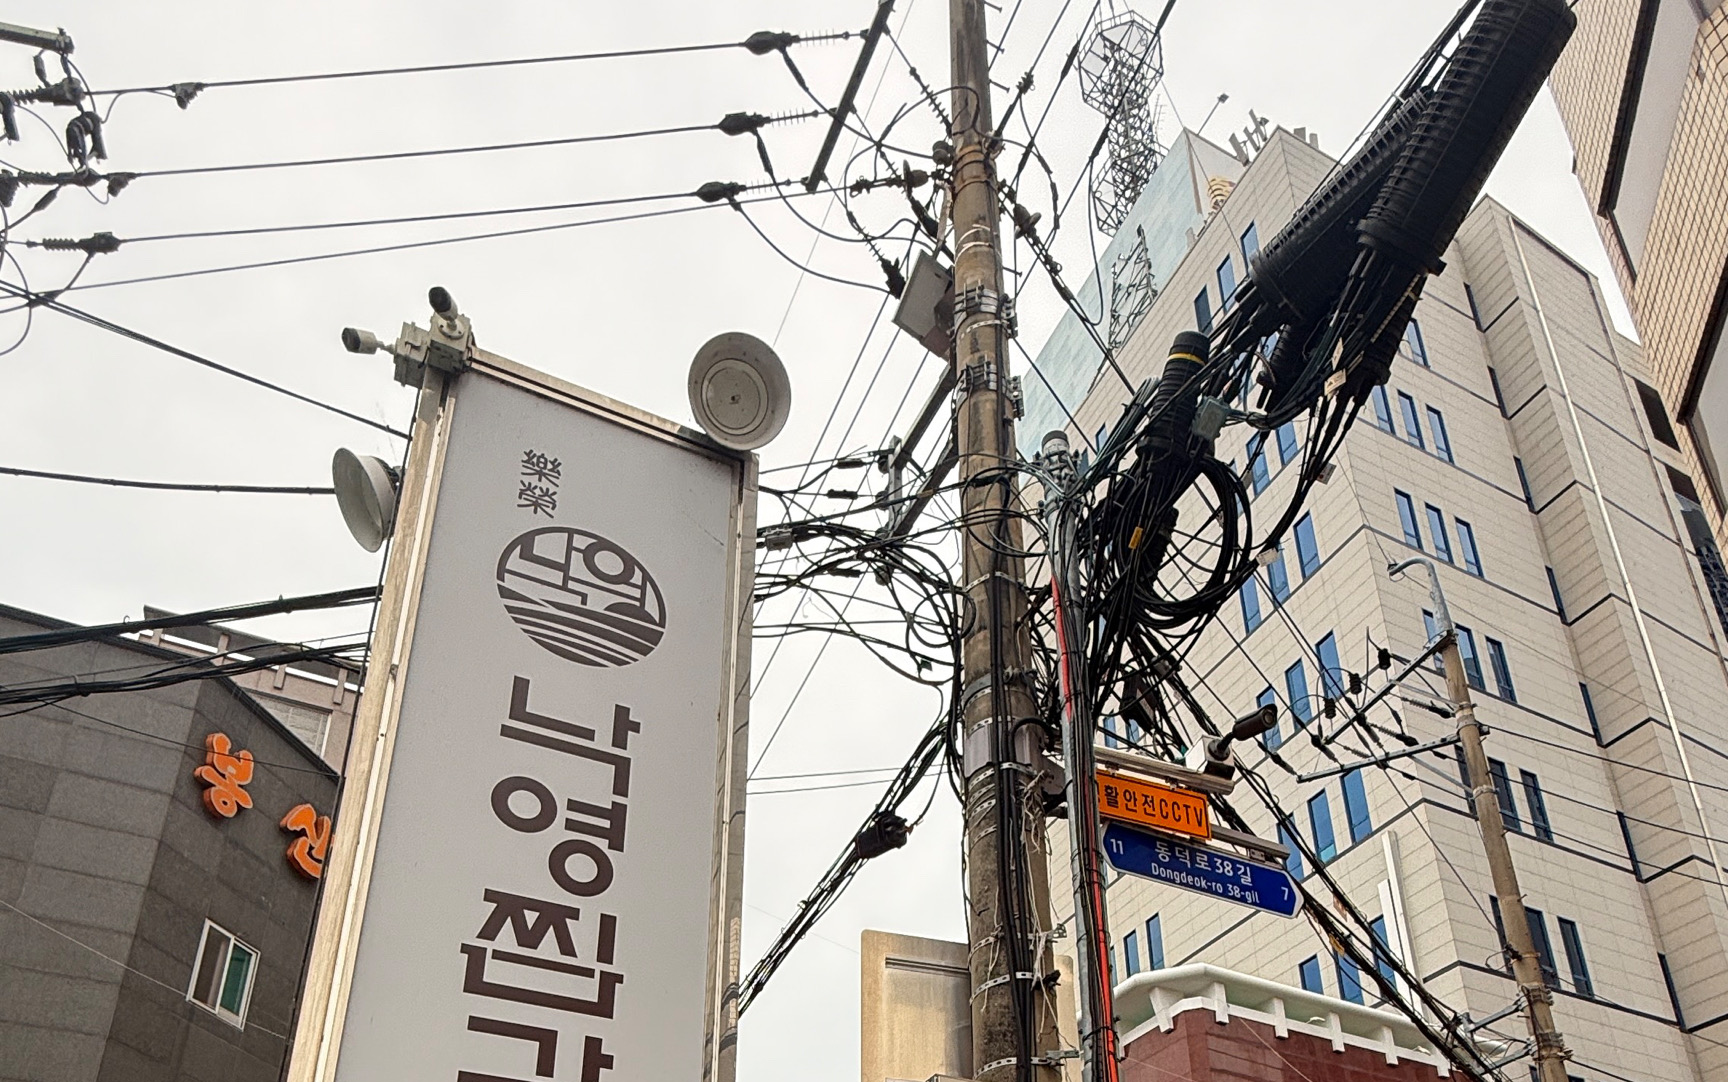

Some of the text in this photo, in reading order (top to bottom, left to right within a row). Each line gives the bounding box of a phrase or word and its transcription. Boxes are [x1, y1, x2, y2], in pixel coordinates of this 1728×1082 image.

[1099, 784, 1203, 827] 활안전CCTV
[1109, 838, 1124, 855] 11
[1154, 841, 1253, 886] 동덕로38길
[1151, 862, 1260, 904] Dongdeok-ro 38-gil
[1280, 886, 1289, 901] 7
